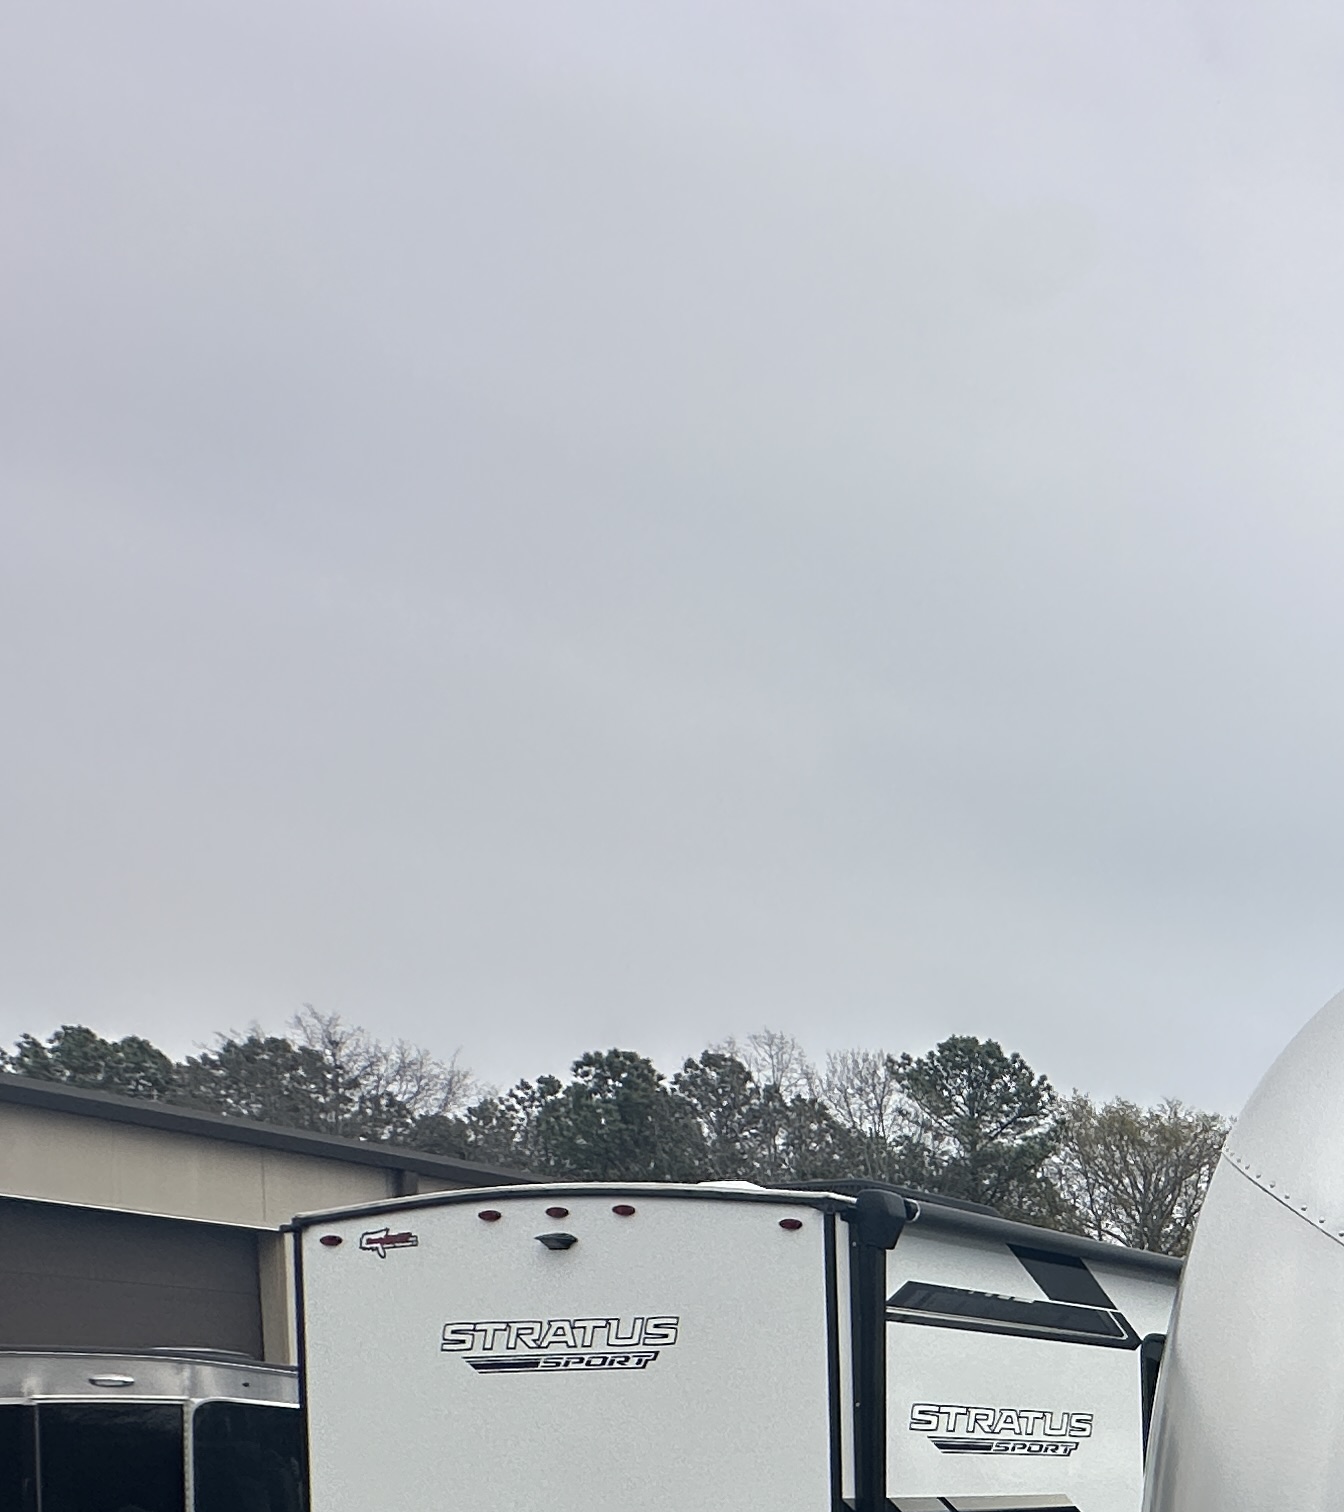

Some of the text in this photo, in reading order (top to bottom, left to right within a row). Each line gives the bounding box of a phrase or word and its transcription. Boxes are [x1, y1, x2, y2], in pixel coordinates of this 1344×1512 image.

[440, 1316, 680, 1351] STRATUS
[538, 1354, 656, 1369] SPORT
[908, 1403, 1094, 1437] STRATUS
[992, 1441, 1078, 1455] SPORT
